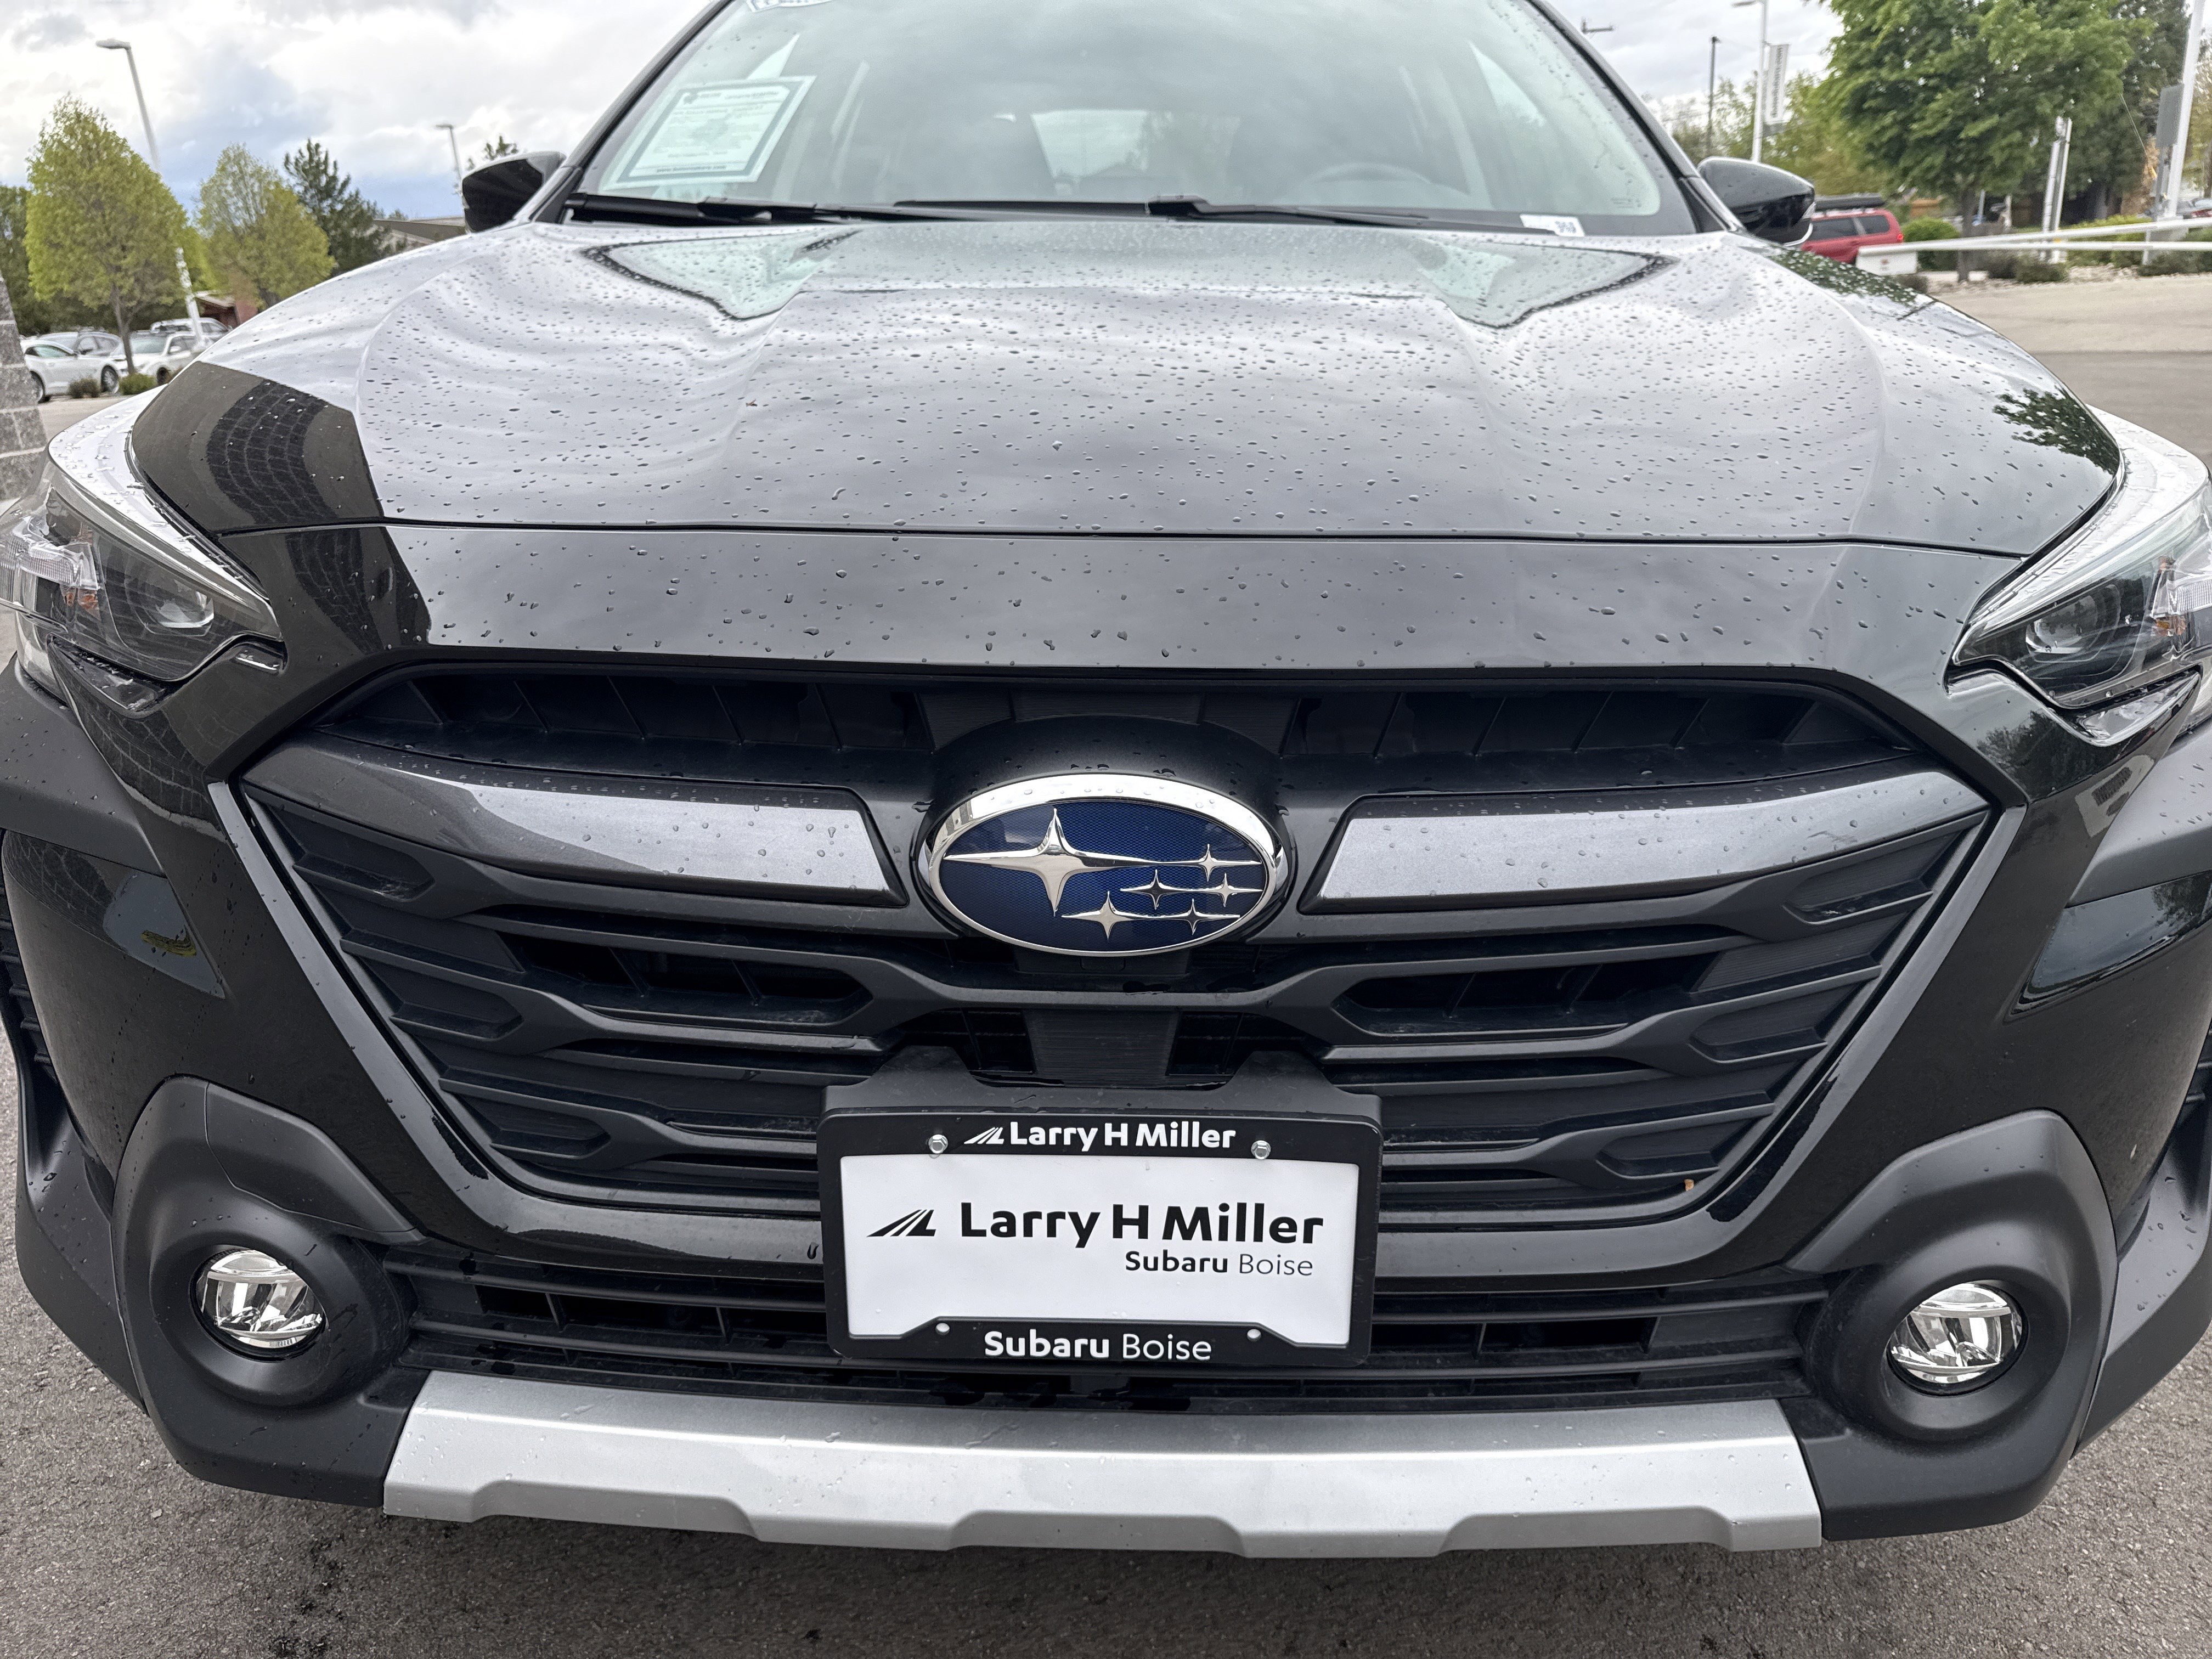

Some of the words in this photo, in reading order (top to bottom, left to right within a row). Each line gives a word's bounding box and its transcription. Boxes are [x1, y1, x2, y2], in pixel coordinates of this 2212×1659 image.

[1011, 1121, 1098, 1152] Larry
[1104, 1122, 1128, 1146] H
[1136, 1121, 1236, 1148] Miller
[961, 1202, 1101, 1248] Larry
[1113, 1204, 1149, 1240] H
[1162, 1202, 1324, 1244] Miller
[1126, 1250, 1228, 1273] Subaru
[1239, 1253, 1313, 1277] Boise
[984, 1329, 1109, 1358] Subaru
[1122, 1334, 1211, 1360] Boise
